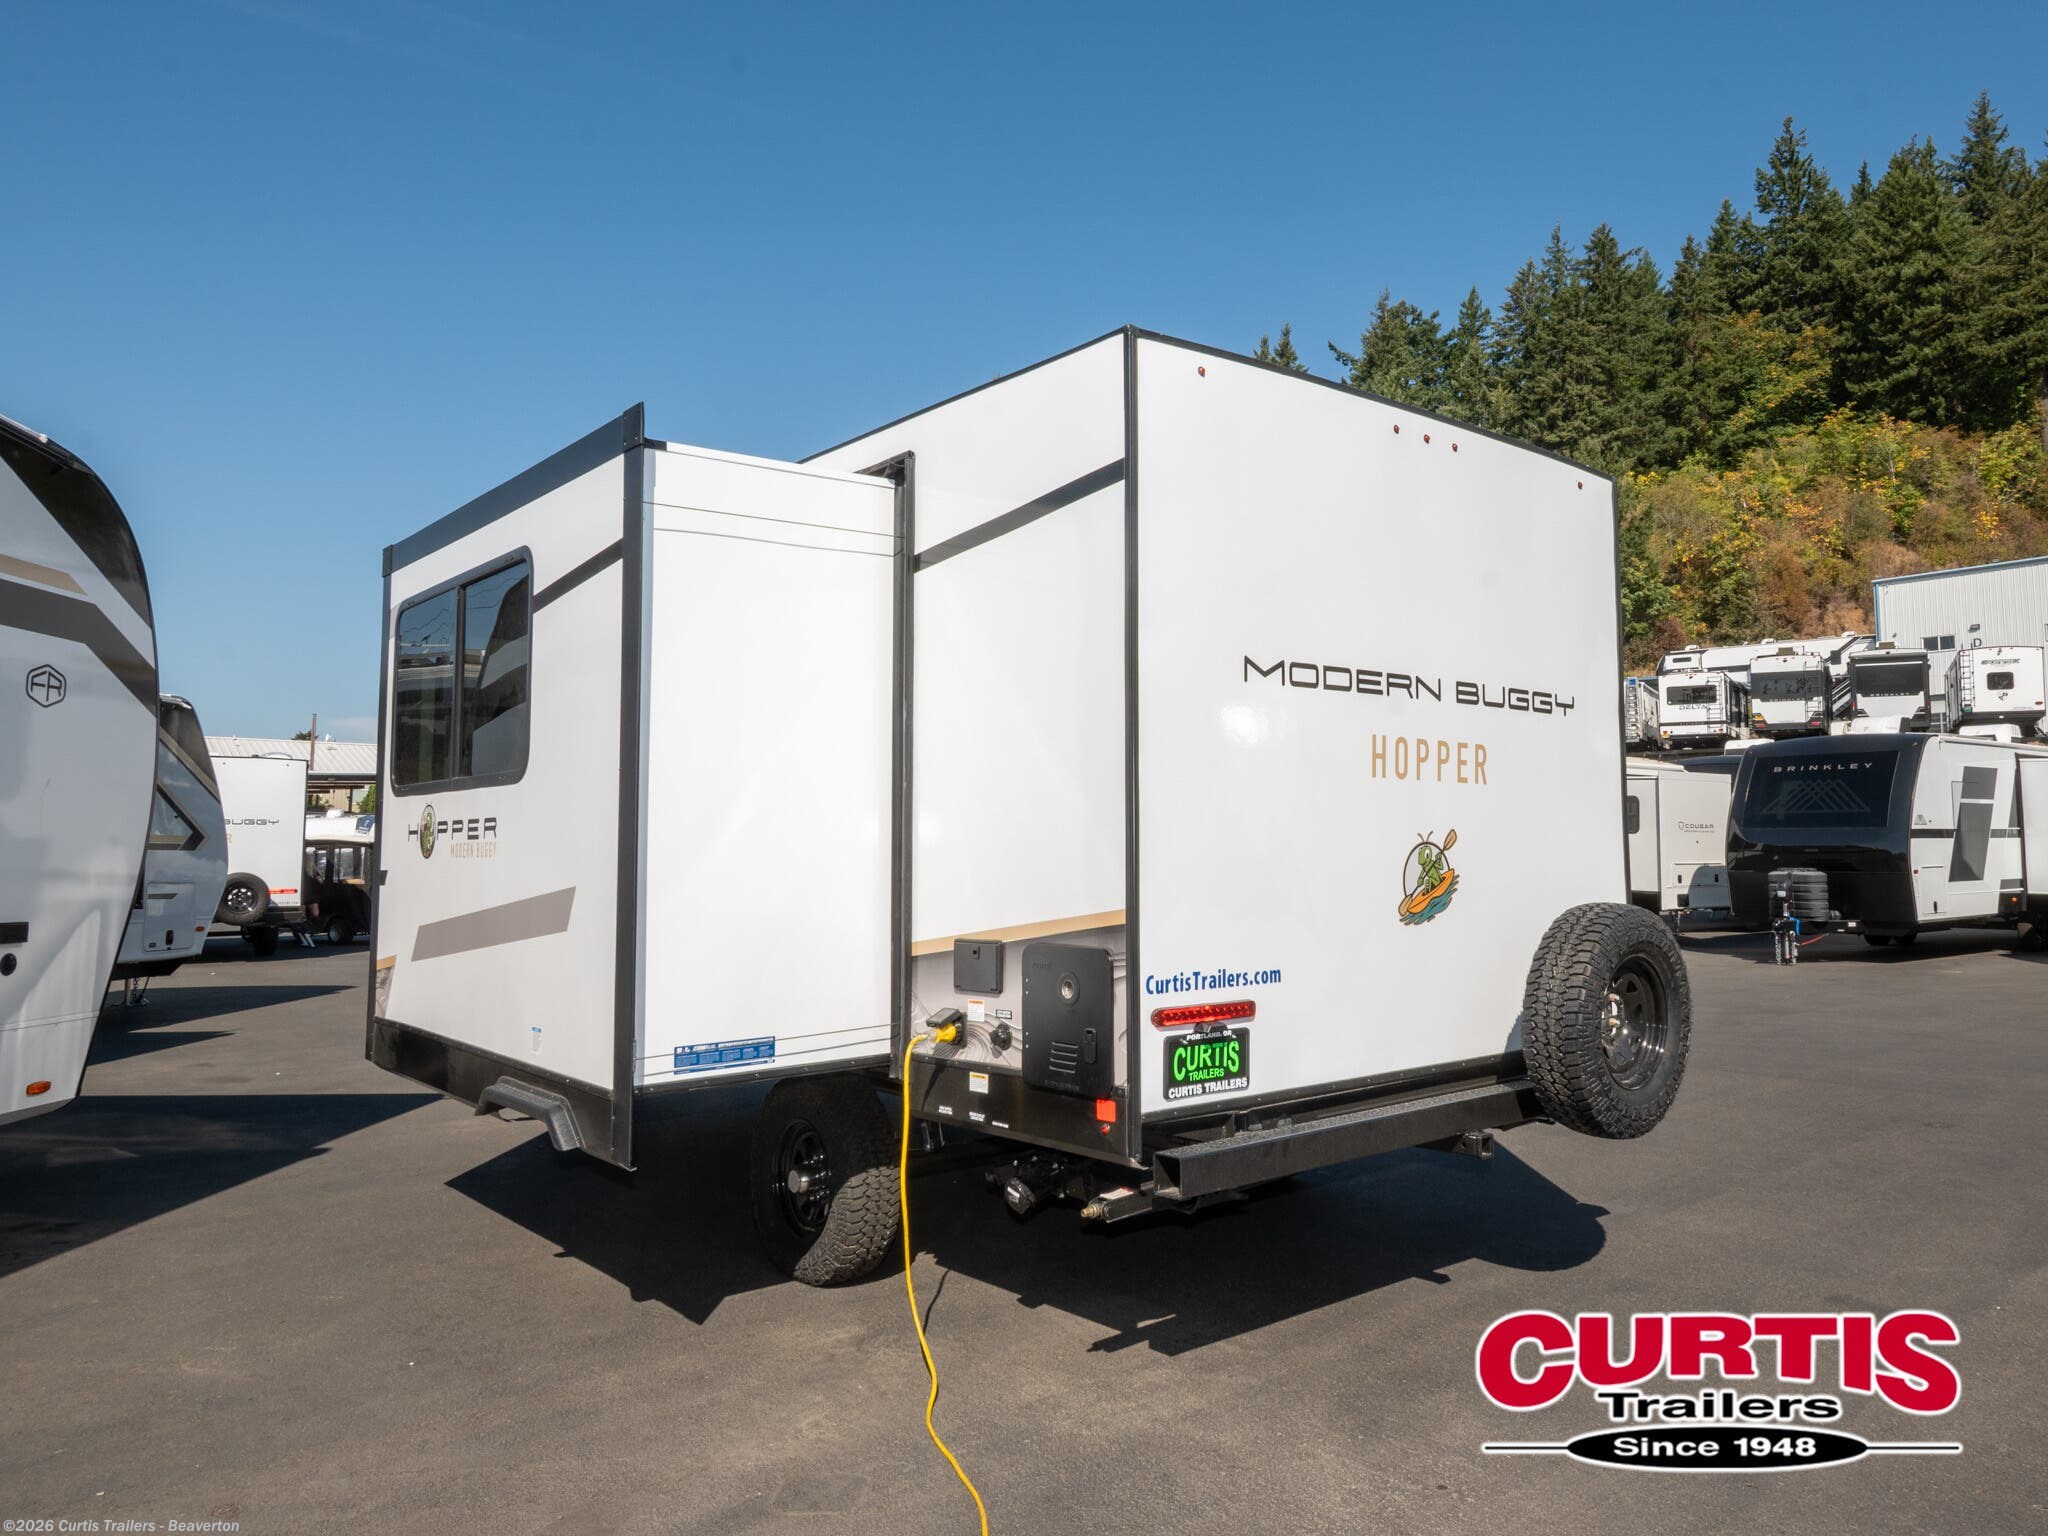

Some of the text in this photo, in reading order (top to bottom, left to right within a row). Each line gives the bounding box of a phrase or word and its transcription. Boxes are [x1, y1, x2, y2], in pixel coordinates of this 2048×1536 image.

[1243, 655, 1575, 717] MODERN BUGGY
[1371, 733, 1488, 785] HOPPER
[1772, 762, 1873, 773] BRINKLEY
[1145, 968, 1282, 995] CurtisTrailers.com
[1173, 1040, 1240, 1081] CURTIS
[1168, 1076, 1248, 1099] CURTIS TRAILERS
[1188, 1068, 1225, 1082] TRAILERS
